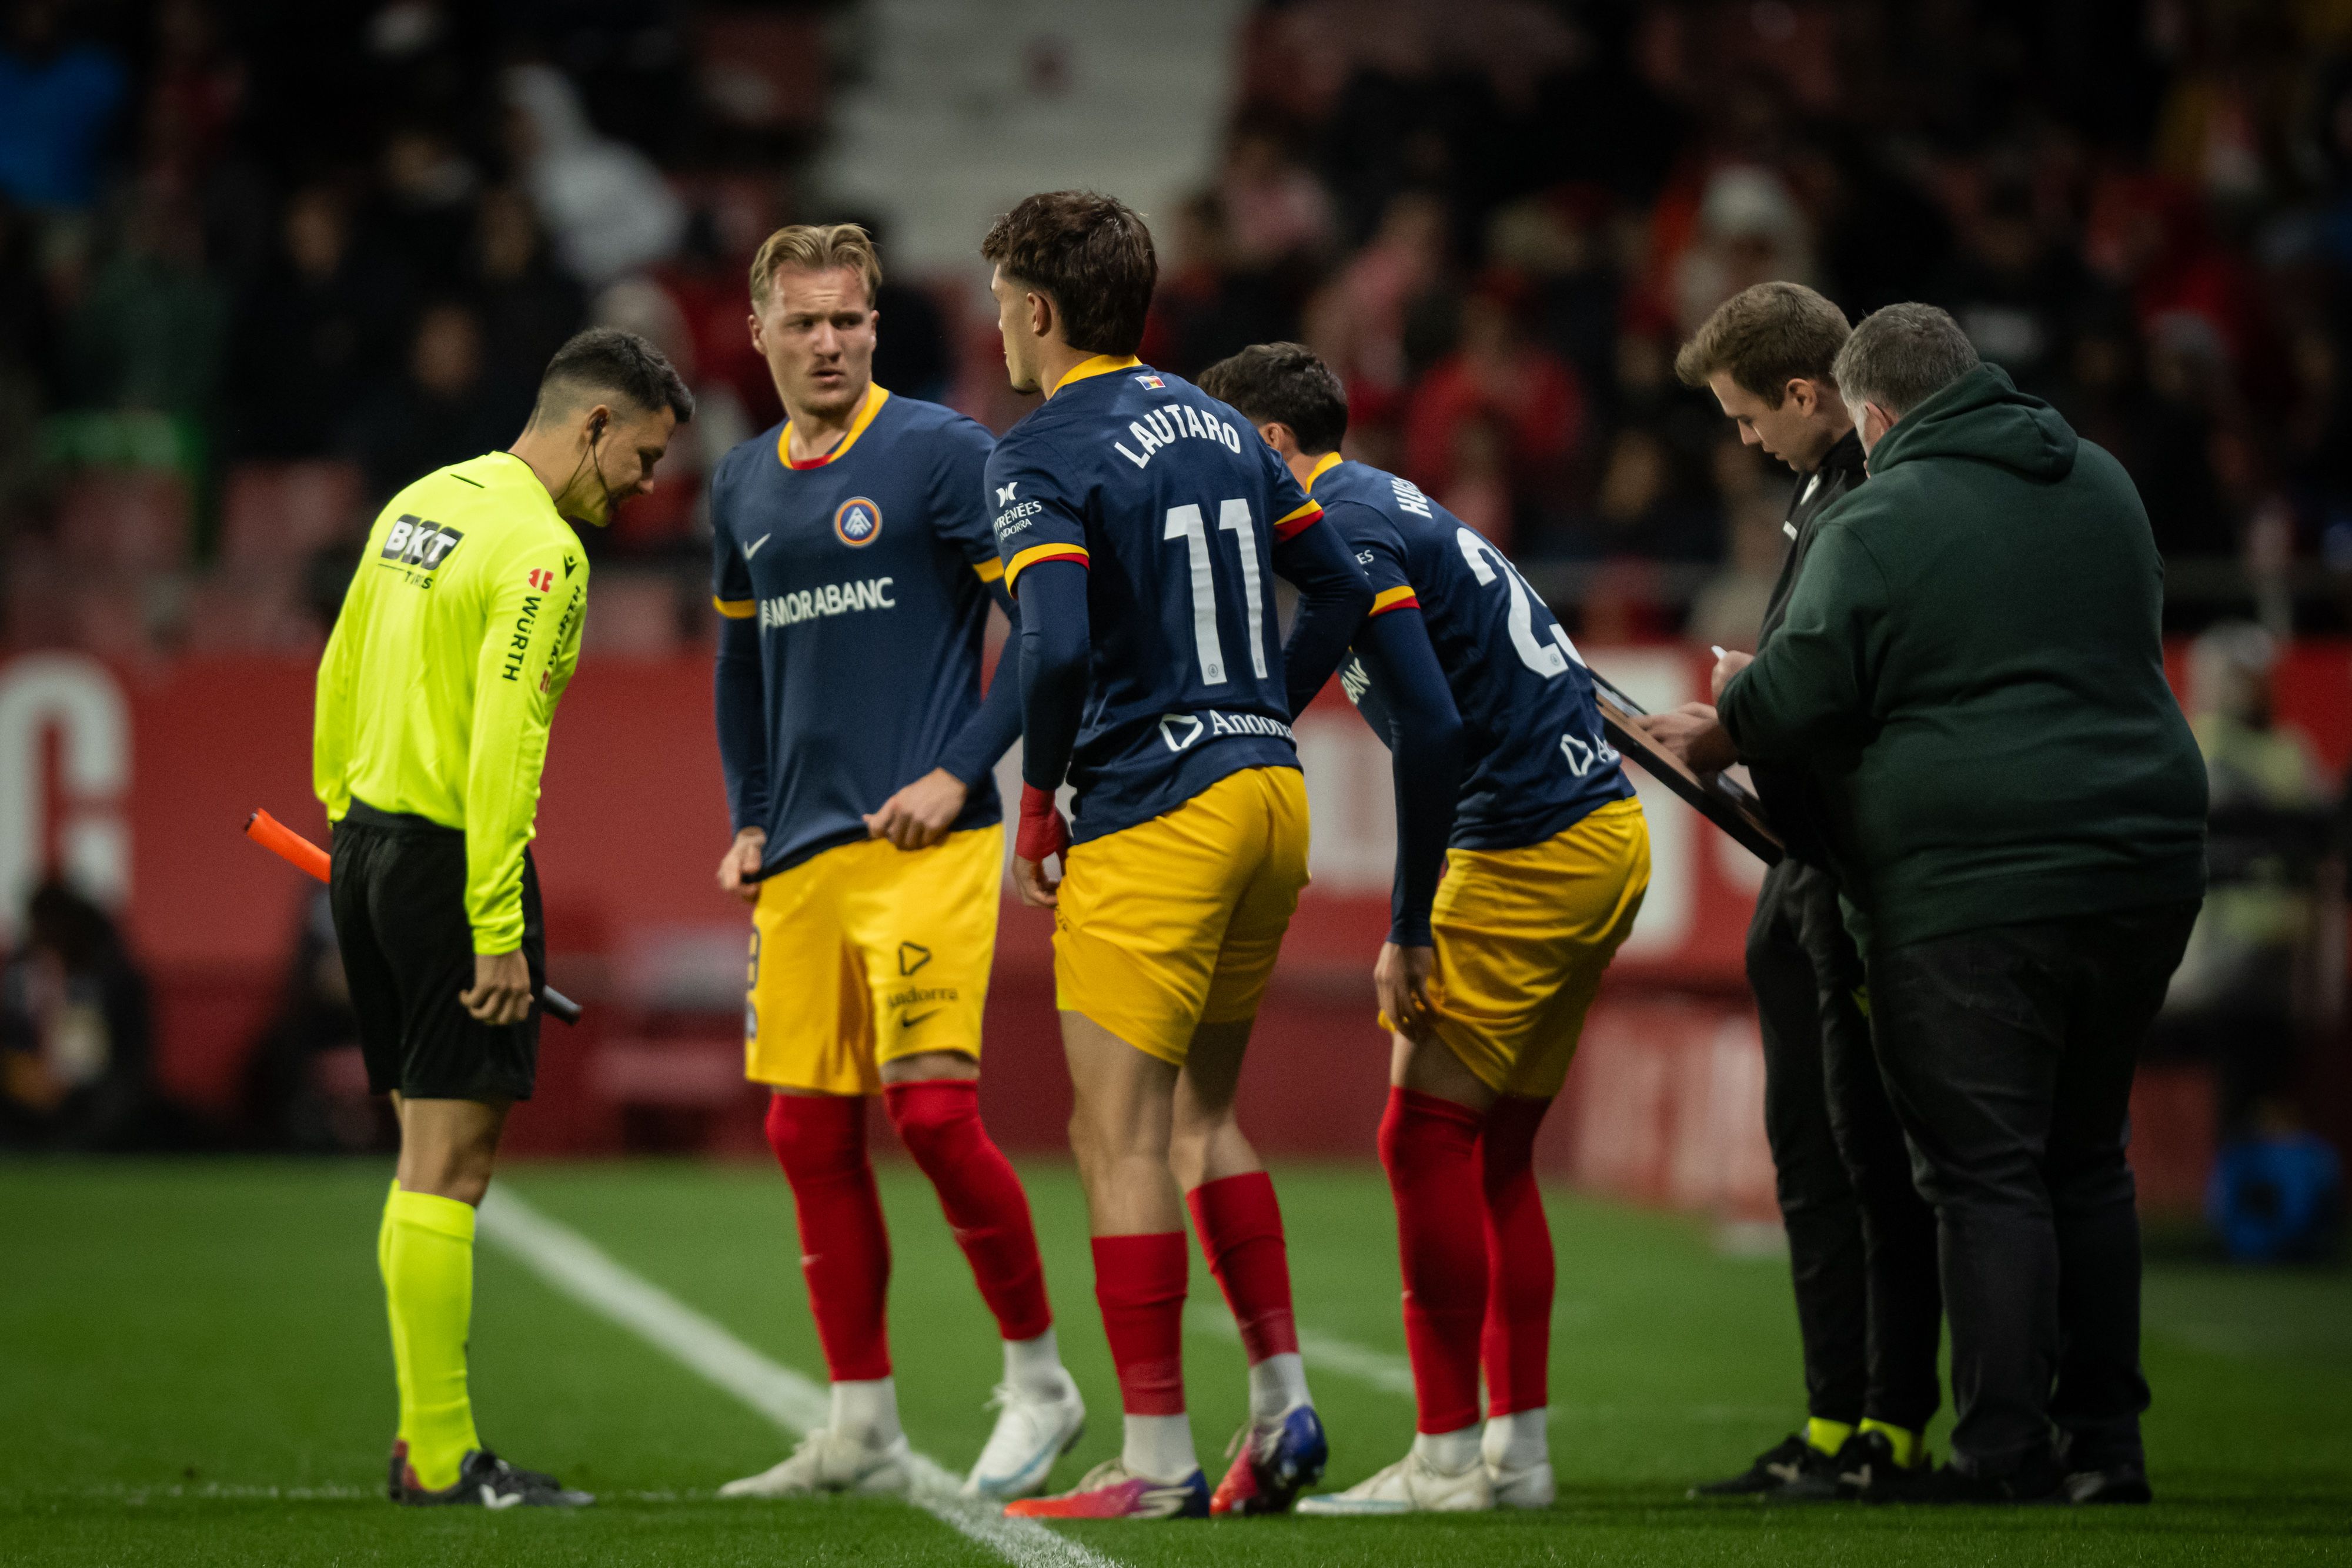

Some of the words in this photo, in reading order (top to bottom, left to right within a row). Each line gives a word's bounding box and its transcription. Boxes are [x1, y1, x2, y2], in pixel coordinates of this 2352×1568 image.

[1115, 404, 1241, 469] LAUTARO
[384, 519, 459, 564] BKT
[770, 577, 896, 628] MORABANC
[1164, 499, 1268, 686] 11
[502, 596, 542, 681] WÜRTH
